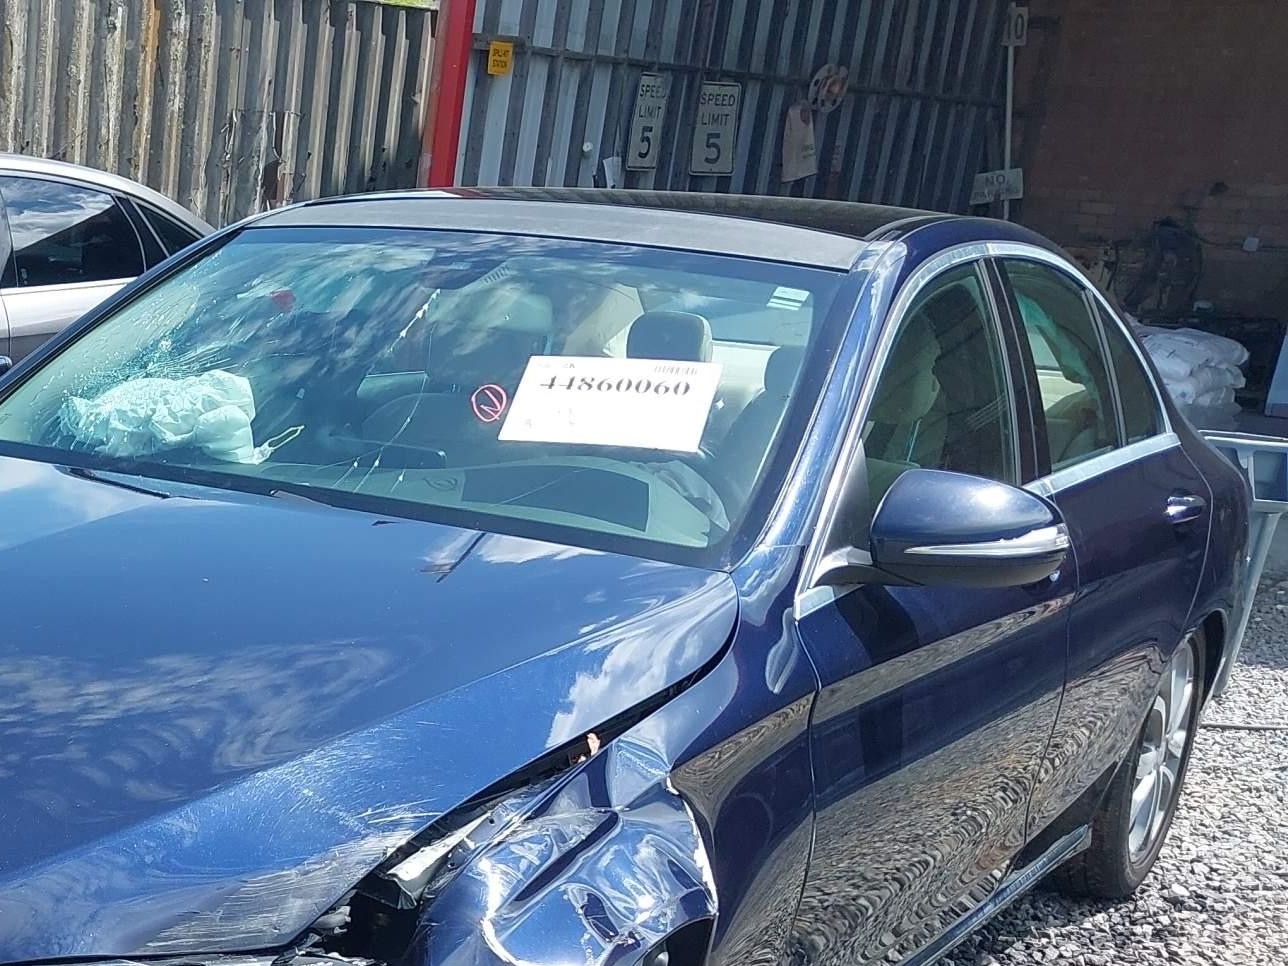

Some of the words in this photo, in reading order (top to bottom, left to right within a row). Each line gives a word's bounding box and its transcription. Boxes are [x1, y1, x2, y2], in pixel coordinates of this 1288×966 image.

[639, 84, 666, 99] SPEED
[700, 93, 736, 106] SPEED
[638, 104, 662, 118] LIMIT
[701, 112, 730, 125] LIMIT
[638, 126, 654, 159] 5
[704, 132, 721, 164] 5
[540, 375, 692, 396] 44860060
